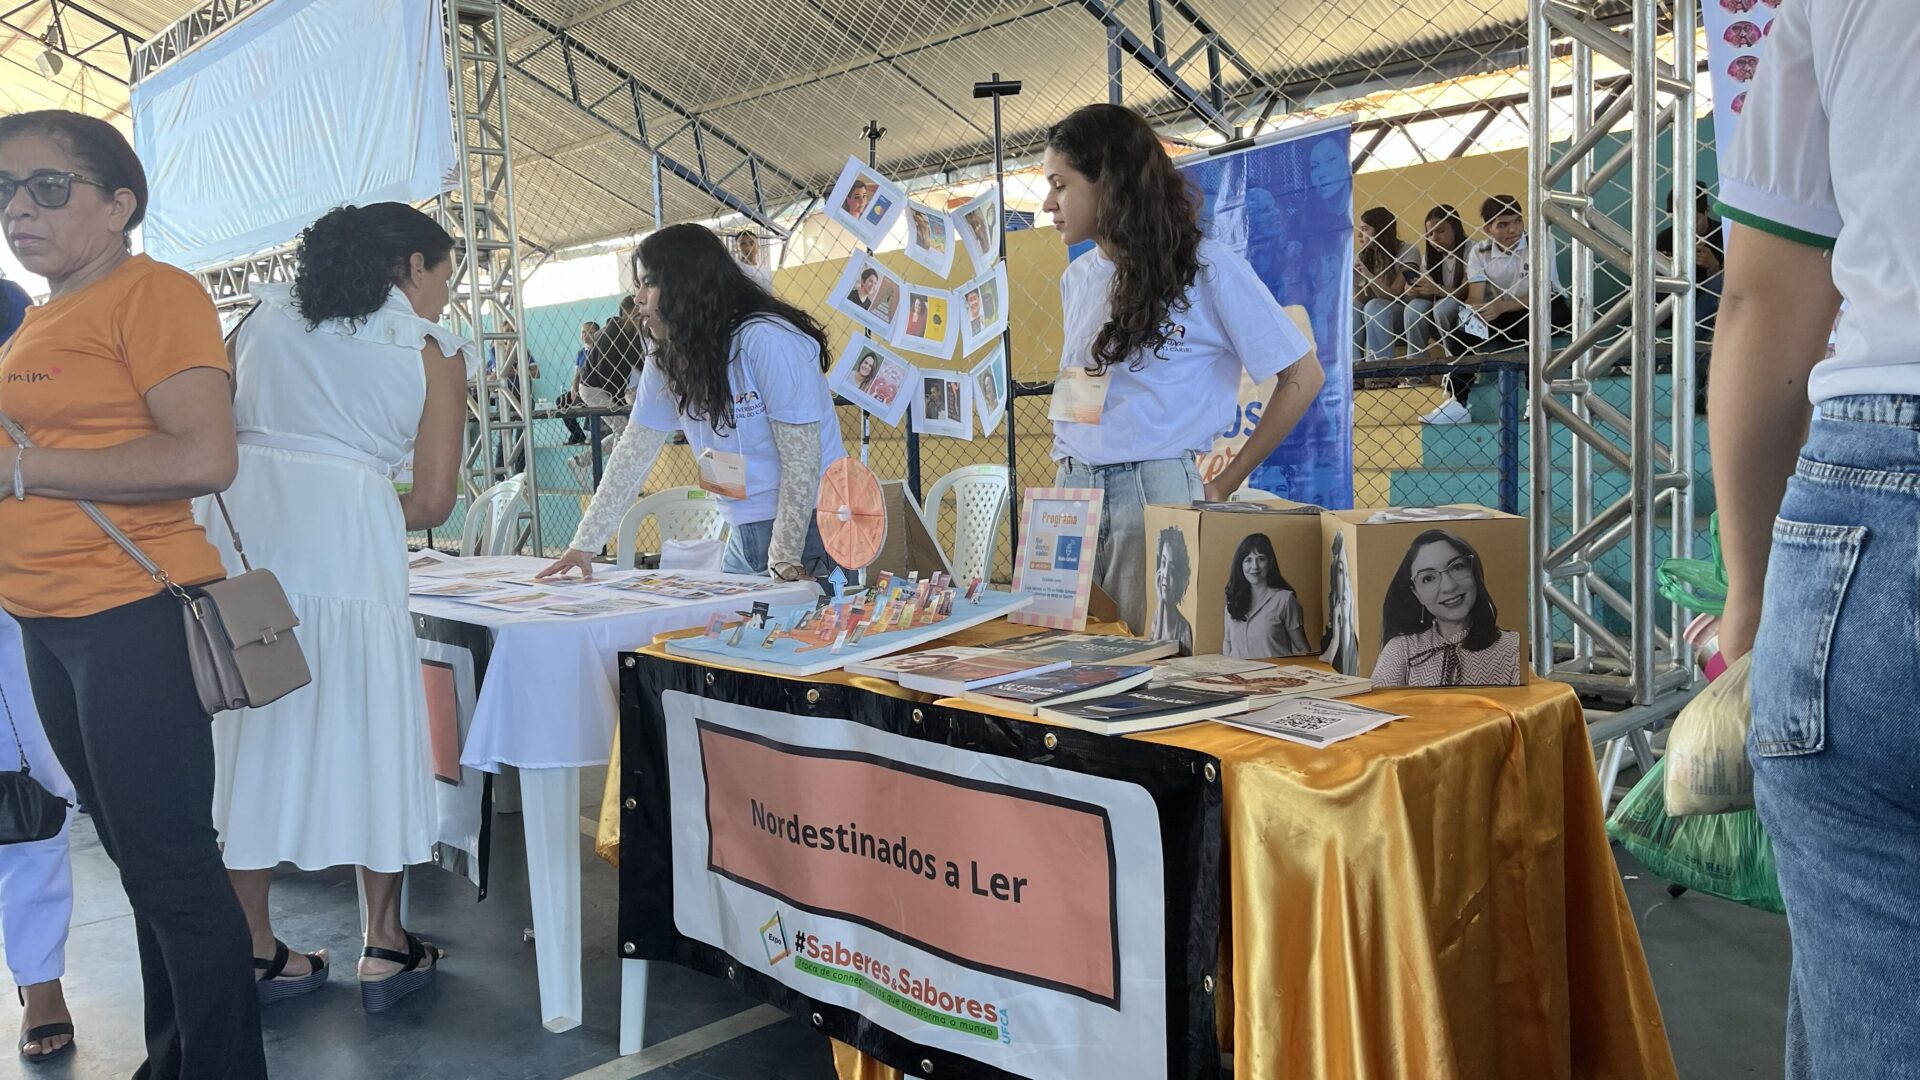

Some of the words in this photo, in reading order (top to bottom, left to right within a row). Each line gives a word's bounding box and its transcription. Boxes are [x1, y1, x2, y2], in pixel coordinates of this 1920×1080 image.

[1042, 512, 1078, 528] Programa
[750, 798, 937, 880] Nordestinados
[945, 861, 960, 889] a
[971, 860, 1028, 904] Ler
[768, 933, 782, 945] Expo
[798, 958, 818, 973] Troca
[821, 966, 831, 976] de
[887, 993, 900, 1007] que
[901, 1000, 946, 1024] transforma
[949, 1018, 956, 1026] o
[959, 1021, 993, 1036] mundo
[998, 1008, 1011, 1045] UFCA
